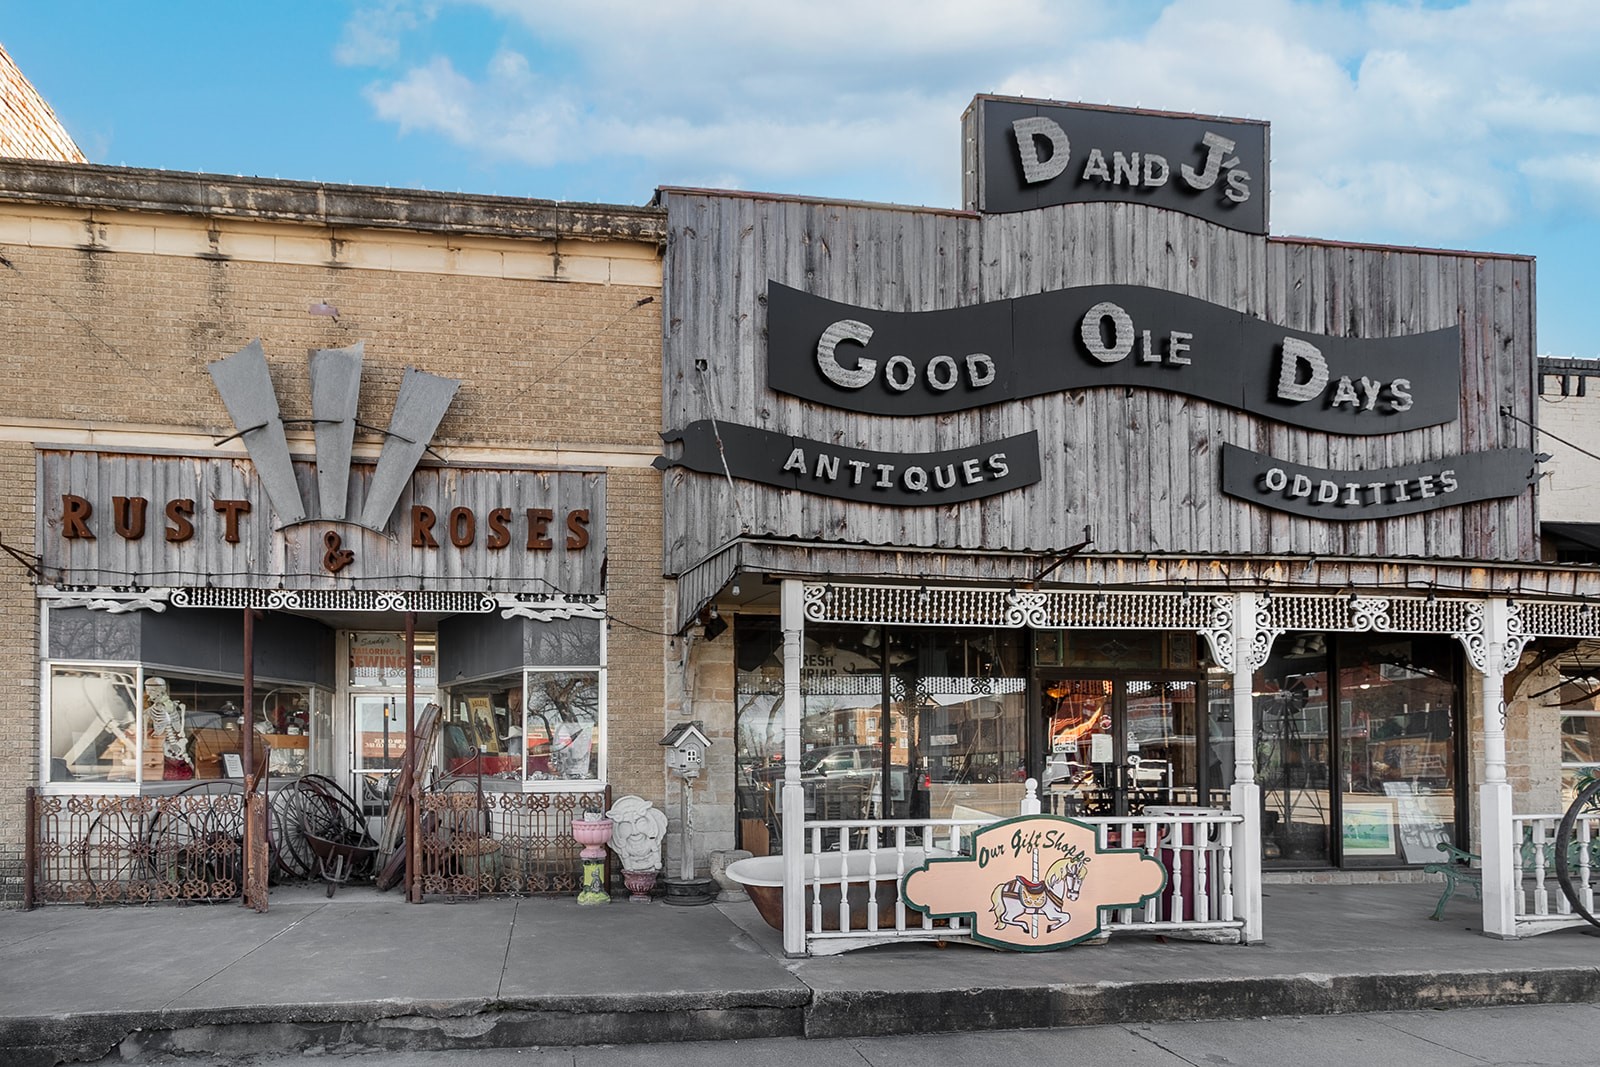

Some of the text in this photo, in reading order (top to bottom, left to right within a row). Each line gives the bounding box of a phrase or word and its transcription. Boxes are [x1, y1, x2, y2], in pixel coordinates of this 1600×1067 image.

[1012, 116, 1070, 184] D
[1082, 148, 1170, 187] AND
[816, 302, 1414, 413] GOOD OLE DAYS
[783, 447, 1010, 493] ANTIQUES
[1265, 468, 1459, 506] ODDITIES
[61, 494, 590, 574] RUST & ROSES
[352, 647, 395, 655] TAILORING
[803, 654, 834, 667] RESH
[800, 668, 838, 681] HRIMP
[978, 828, 1091, 868] Our Gift Shoppe
